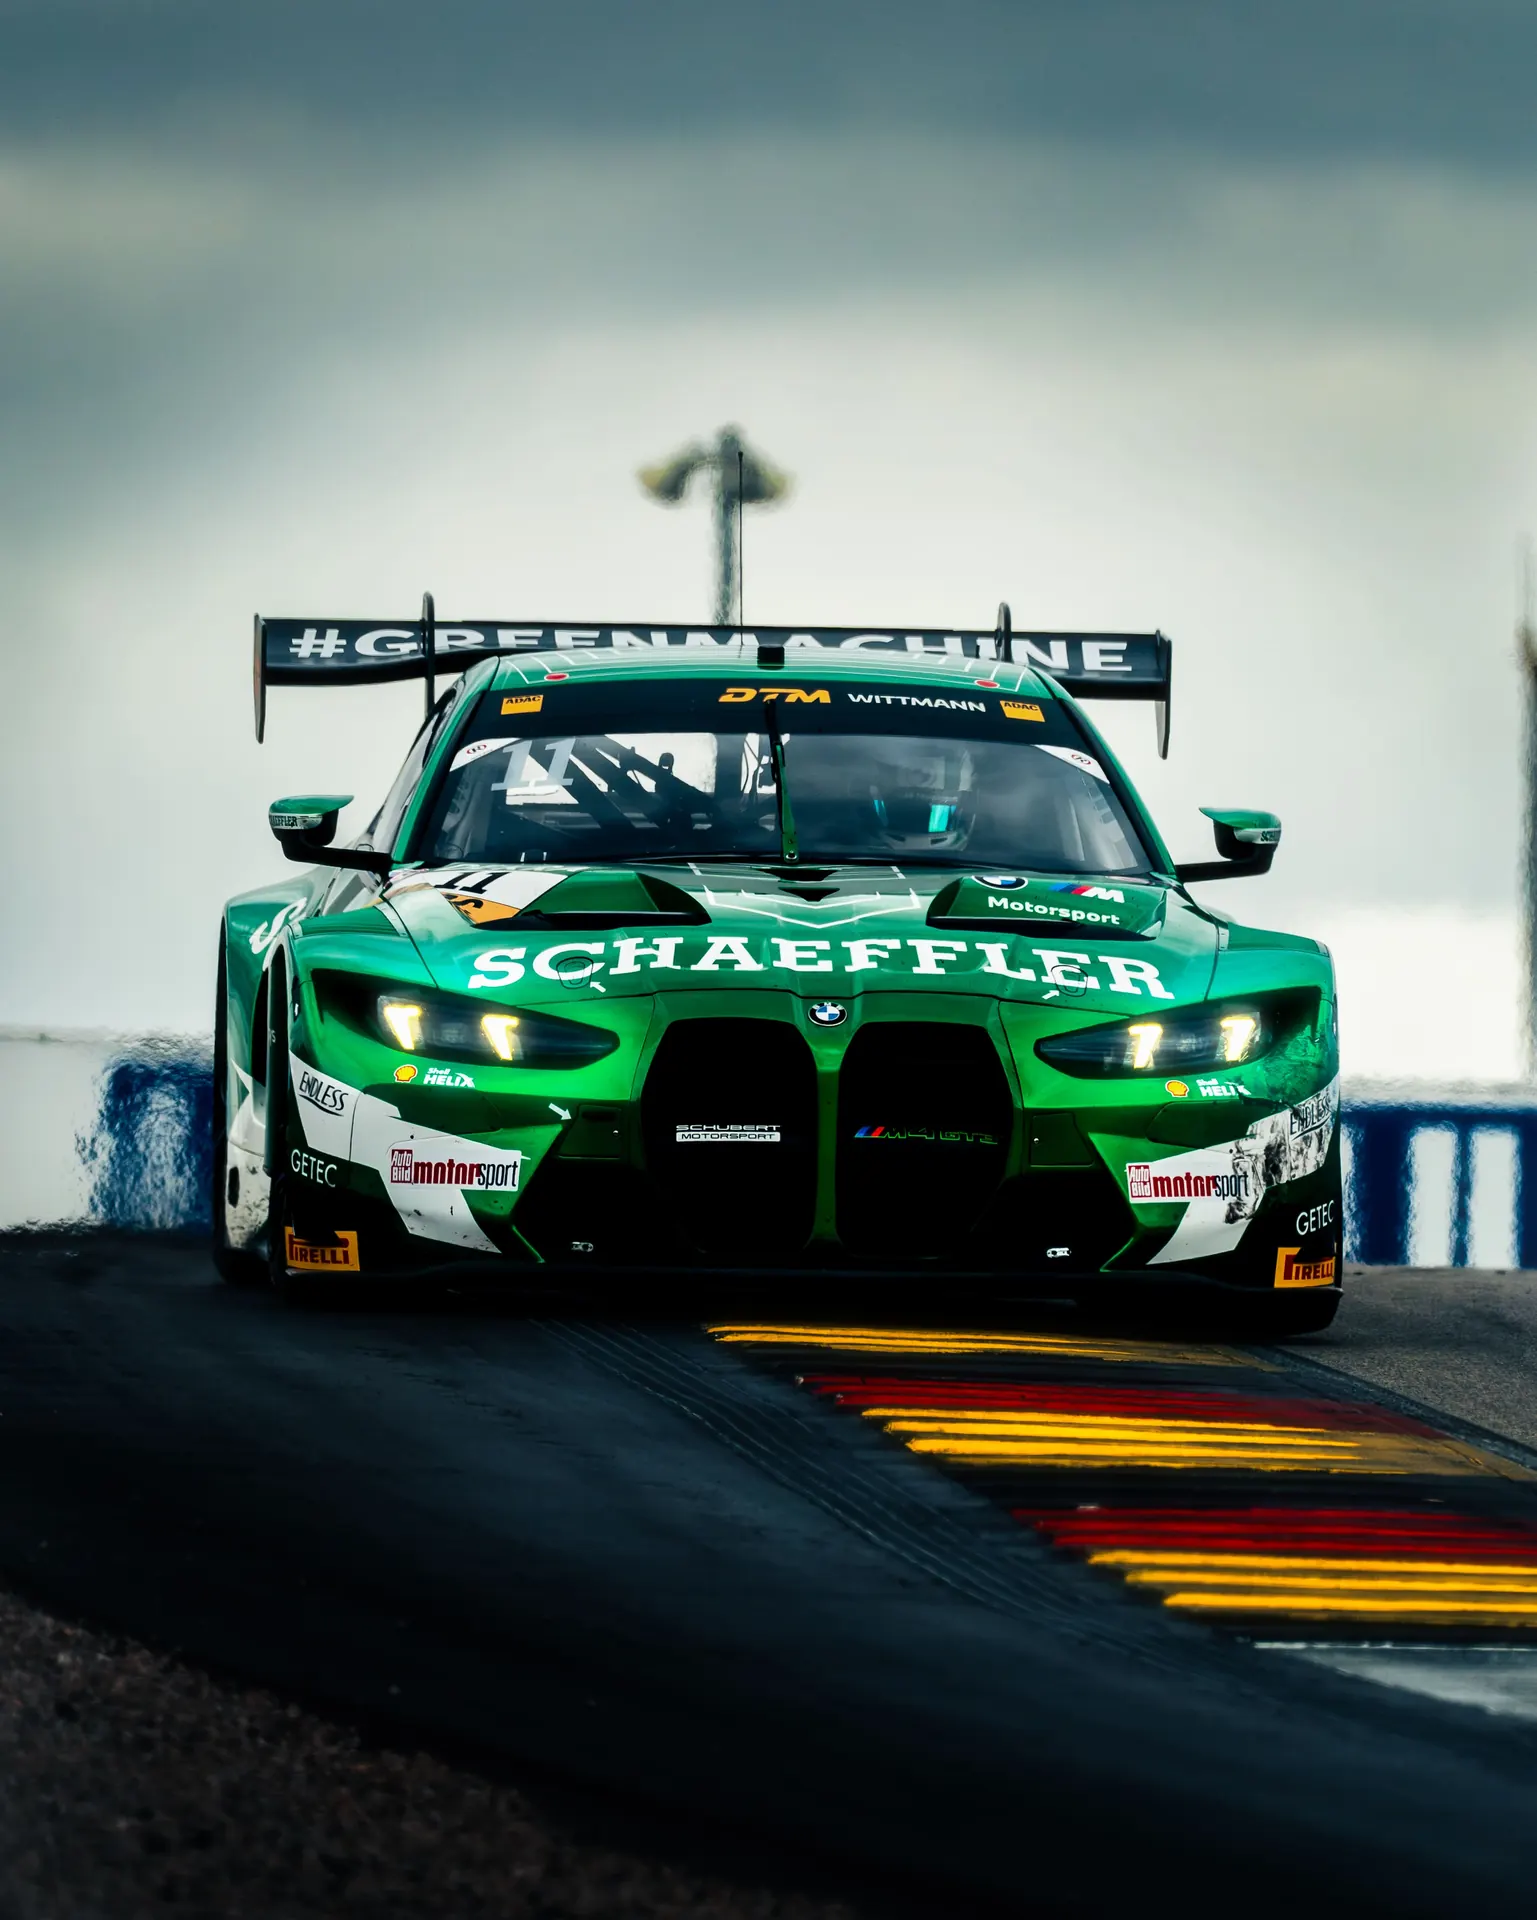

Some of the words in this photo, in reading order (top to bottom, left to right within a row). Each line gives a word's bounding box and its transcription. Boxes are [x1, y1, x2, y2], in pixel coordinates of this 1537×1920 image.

[505, 695, 541, 705] ADAC
[718, 687, 832, 704] DTM
[847, 693, 986, 713] WITTMANN
[1003, 702, 1039, 712] ADAC
[491, 736, 576, 791] 11
[433, 871, 511, 895] 11
[987, 895, 1120, 925] Motorsport
[467, 936, 1175, 1000] SCHAEFFLER
[423, 1073, 475, 1088] HELIX
[427, 1067, 451, 1076] Shell
[299, 1070, 349, 1111] ENDLESS
[291, 1148, 337, 1188] GETEC
[392, 1150, 412, 1167] Auto
[392, 1167, 411, 1182] Bild
[414, 1158, 518, 1189] motorsport
[1129, 1166, 1149, 1182] Auto
[1131, 1181, 1150, 1197] Bild
[1153, 1171, 1249, 1200] motorsport
[1296, 1199, 1335, 1235] GETEC
[288, 1233, 350, 1265] PIRELLI
